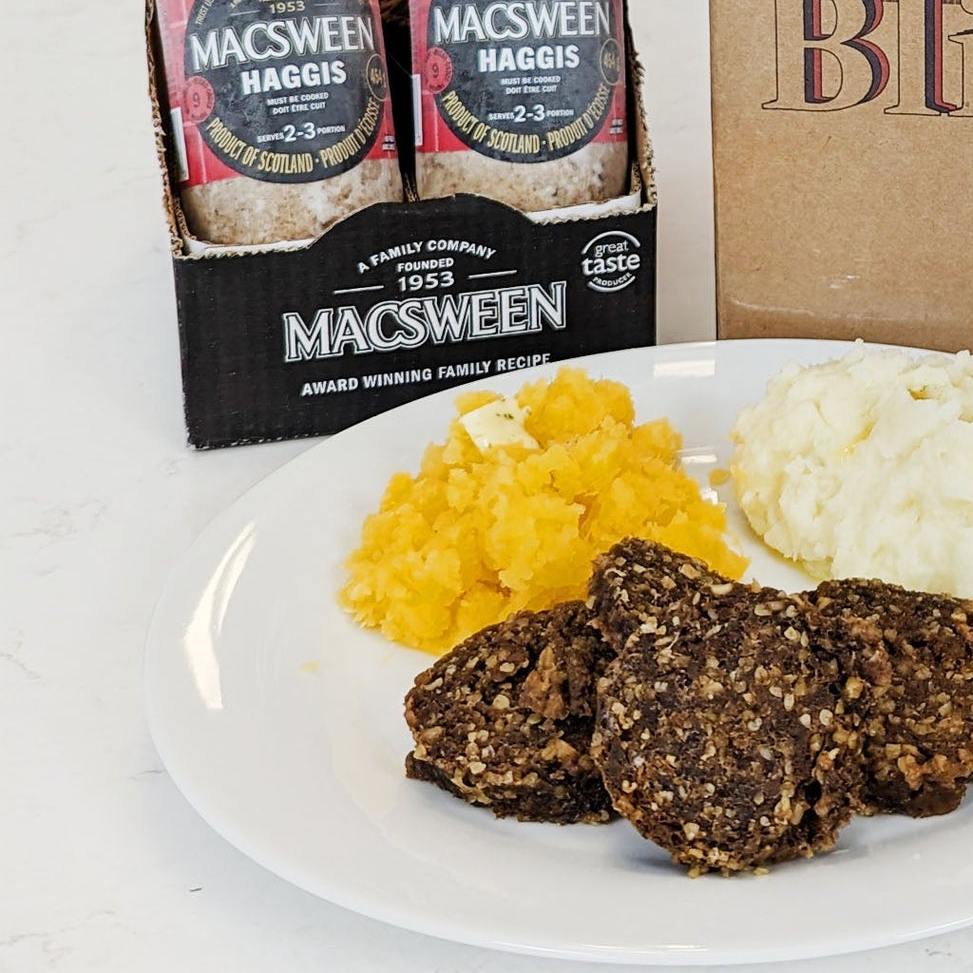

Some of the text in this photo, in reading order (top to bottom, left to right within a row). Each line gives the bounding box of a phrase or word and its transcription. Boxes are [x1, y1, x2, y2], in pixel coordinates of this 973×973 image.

[195, 5, 209, 25] TRUST
[269, 0, 305, 14] 1953
[434, 0, 611, 44] MACSWEEN
[189, 16, 376, 72] MACSWEEN
[478, 45, 580, 73] HAGGIS
[241, 60, 347, 96] HAGGIS
[501, 77, 521, 85] MUST
[533, 75, 561, 83] COOKED
[266, 92, 329, 106] MUST BE COOKED
[506, 87, 521, 95] DOIT
[272, 101, 326, 115] DOIT ÊTRE CUIT
[488, 104, 574, 122] SERVES 2-3 PORTION
[442, 89, 479, 134] PRODUCT
[473, 122, 490, 143] OF
[487, 128, 540, 154] SCOTLAND
[547, 117, 588, 151] PRODUIT
[257, 122, 346, 143] SERVES 2-3 PORTION
[206, 116, 247, 160] PRODUCT
[242, 145, 260, 167] OF
[258, 150, 314, 174] SCOTLAND
[320, 132, 362, 168] PRODUIT
[357, 239, 497, 274] A FAMILY COMPANY
[594, 239, 629, 258] great
[397, 257, 454, 273] FOUNDED
[581, 253, 641, 276] taste
[397, 270, 455, 292] 1953
[592, 272, 633, 287] PRODUCER
[282, 280, 567, 362] MACSWEEN
[300, 377, 359, 397] AWARD
[363, 368, 433, 389] WINNING
[438, 360, 491, 379] FAMILY
